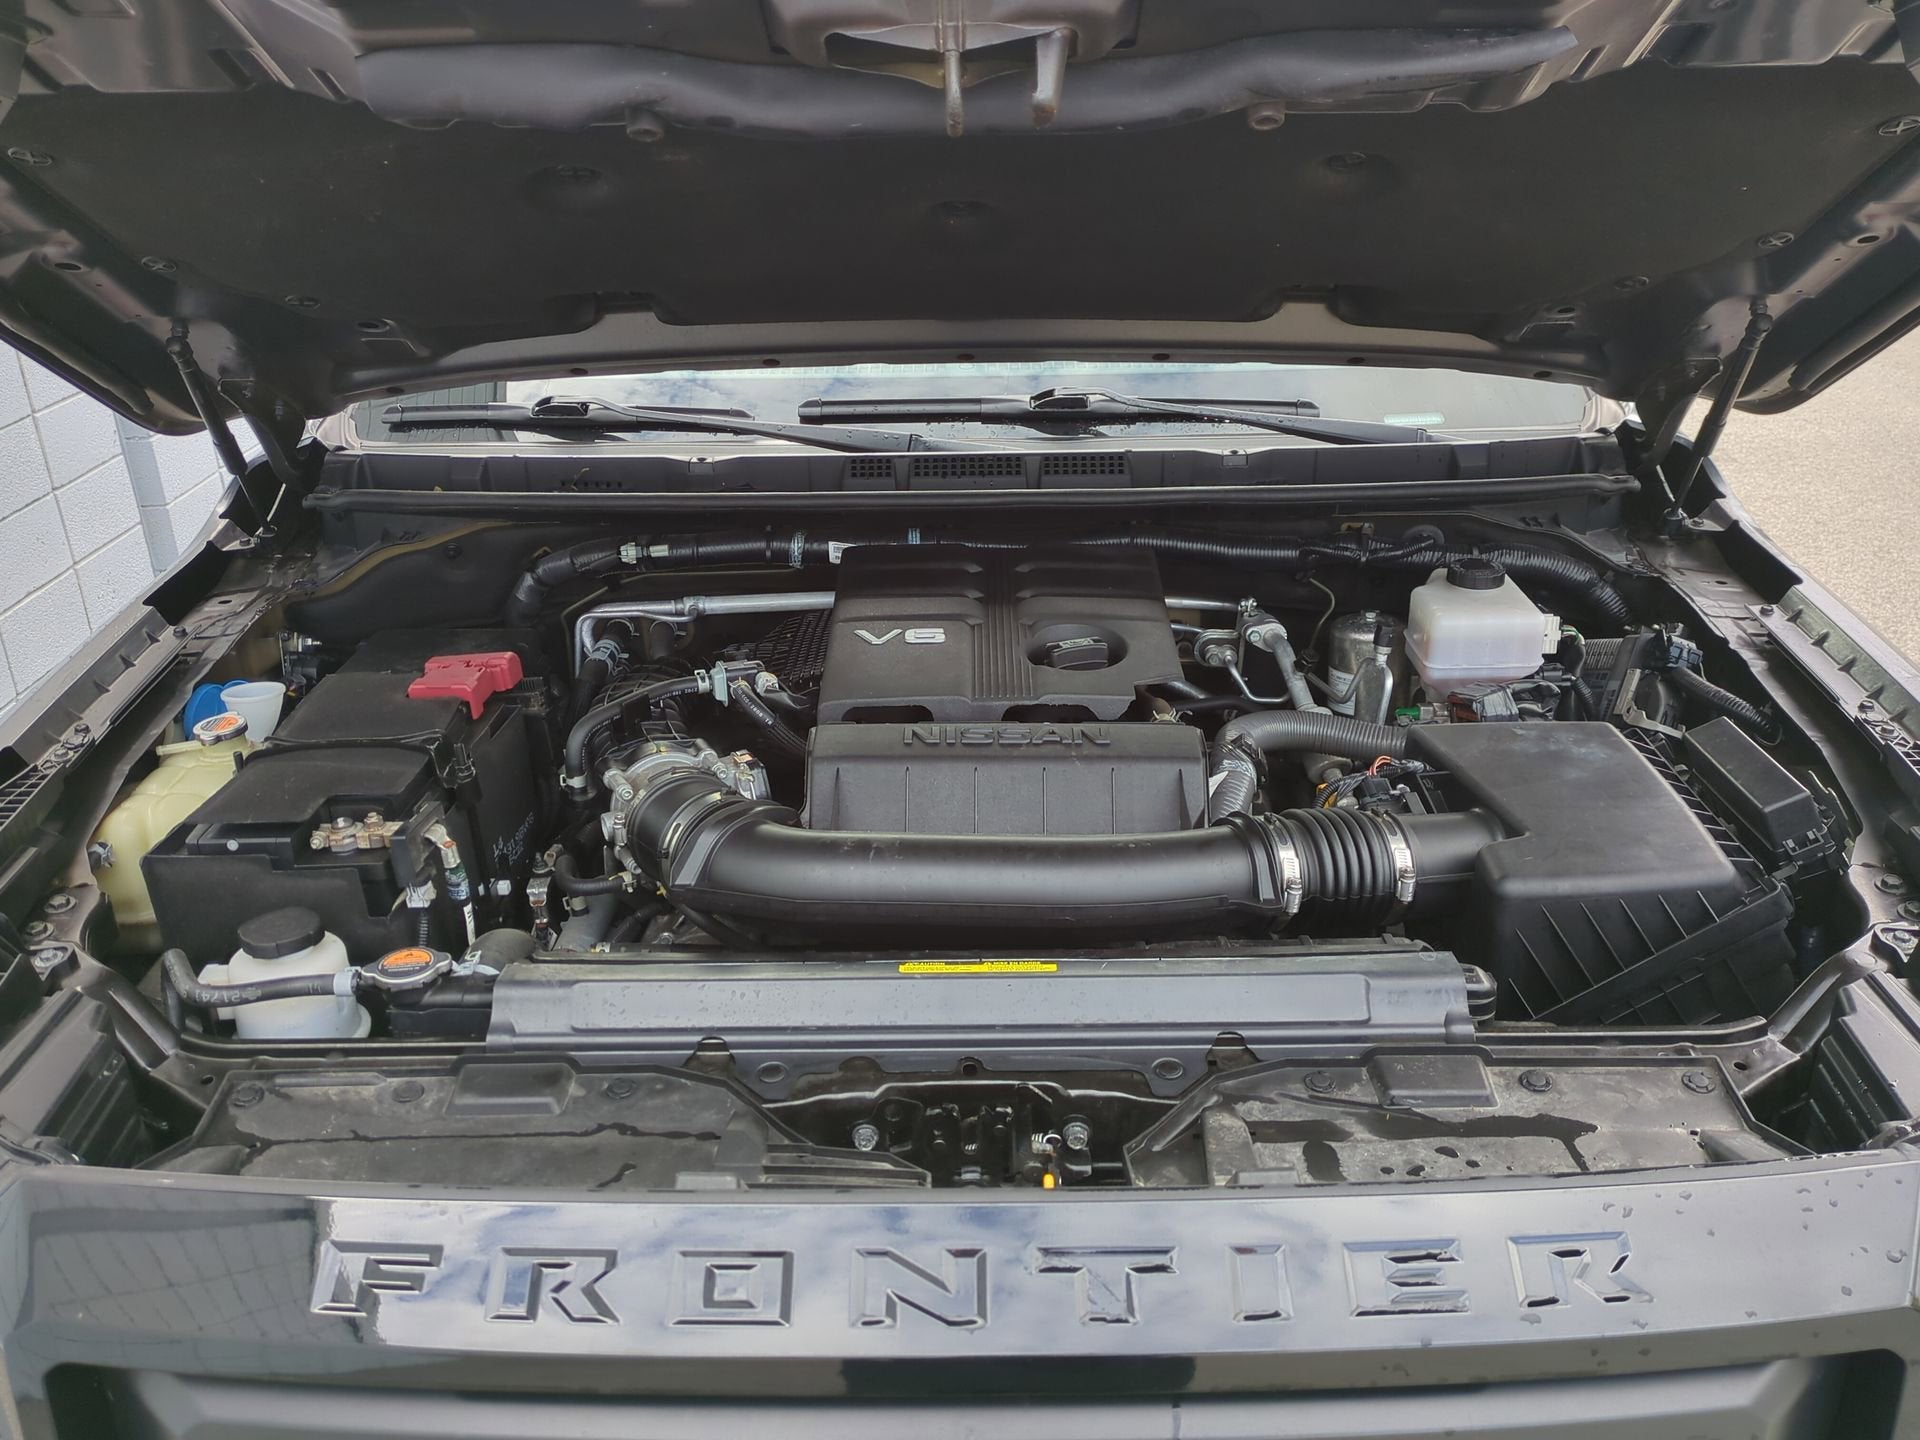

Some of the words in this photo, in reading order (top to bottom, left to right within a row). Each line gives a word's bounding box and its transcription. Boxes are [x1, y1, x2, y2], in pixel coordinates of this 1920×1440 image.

[853, 627, 946, 645] V6
[903, 726, 1111, 744] NISSAN
[310, 1231, 1654, 1328] FRONTIER
